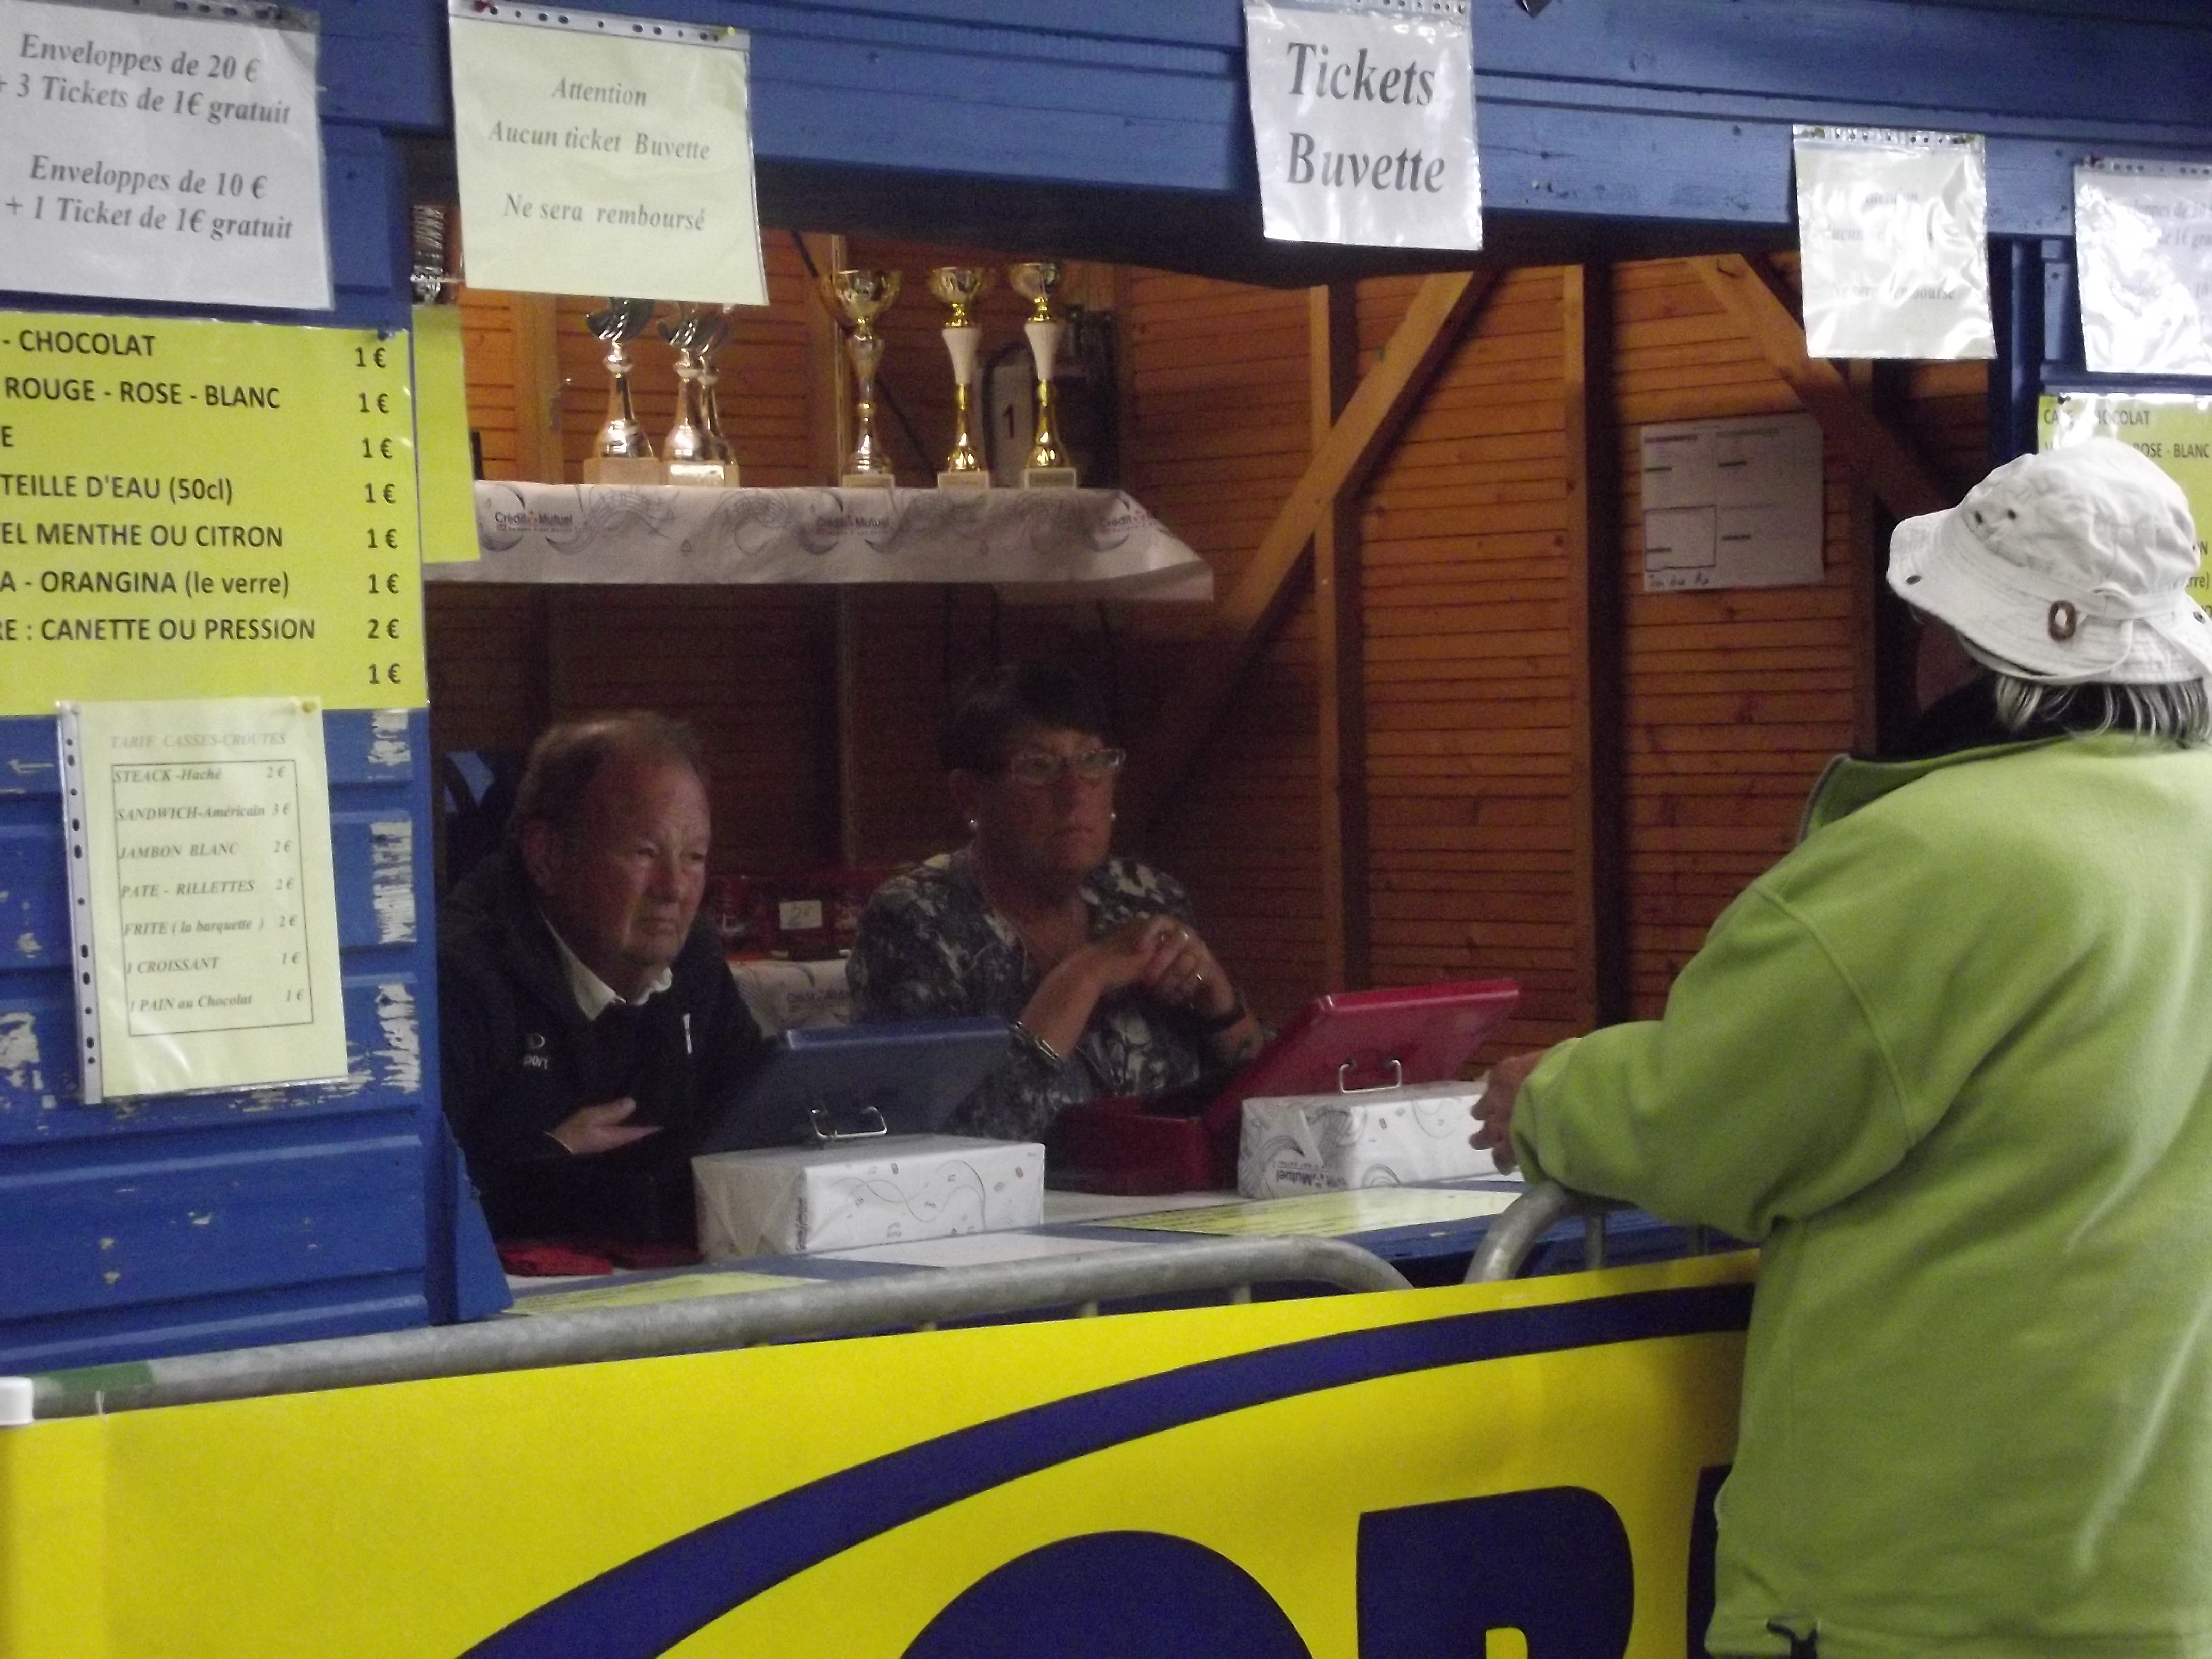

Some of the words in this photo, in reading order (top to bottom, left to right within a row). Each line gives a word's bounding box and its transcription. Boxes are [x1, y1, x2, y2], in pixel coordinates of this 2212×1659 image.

[21, 33, 163, 76] Enveloppes
[171, 51, 200, 76] de
[207, 55, 236, 79] 20
[245, 58, 260, 83] €
[1287, 42, 1435, 105] Tickets
[17, 74, 30, 98] 3
[43, 75, 128, 108] Tickets
[137, 87, 164, 112] de
[208, 100, 290, 125] gratuit
[552, 77, 648, 107] Attention
[489, 120, 557, 146] Aucun
[564, 126, 621, 152] ticket
[635, 132, 711, 161] Buvette
[30, 155, 170, 194] Enveloppes
[179, 170, 206, 194] de
[217, 173, 243, 197] 10
[252, 175, 267, 199] €
[1287, 132, 1445, 193] Buvette
[34, 195, 44, 219] 1
[57, 197, 132, 227] Ticket
[140, 205, 166, 230] de
[211, 216, 292, 240] gratuit
[504, 193, 532, 219] Ne
[540, 202, 583, 221] sera
[596, 204, 705, 231] remboursé
[19, 329, 156, 356] CHOCOLAT
[355, 347, 367, 367] 1
[373, 347, 386, 368] €
[5, 377, 96, 401] ROUGE
[120, 381, 182, 404] ROSE
[205, 384, 280, 409] BLANC
[359, 392, 370, 413] 1
[377, 393, 389, 414] €
[1, 425, 14, 447] E
[362, 437, 373, 458] 1
[380, 438, 393, 459] €
[2173, 443, 2210, 458] BLANC
[0, 474, 77, 496] TEILLE
[87, 475, 160, 499] D'EAU
[169, 477, 233, 504] (50cl)
[365, 483, 376, 503] 1
[383, 483, 396, 504] €
[2, 522, 27, 544] EL
[37, 523, 142, 546] MENTHE
[151, 524, 186, 546] OU
[196, 526, 283, 547] CITRON
[367, 528, 378, 548] 1
[385, 528, 398, 549] €
[0, 571, 16, 593] A
[41, 571, 177, 593] ORANGINA
[186, 570, 214, 598] (le
[222, 570, 289, 599] verre)
[368, 573, 379, 594] 1
[386, 574, 400, 595] €
[41, 619, 150, 641] CANETTE
[159, 619, 195, 640] OU
[205, 619, 315, 640] PRESSION
[367, 619, 379, 639] 2
[386, 619, 400, 640] €
[368, 664, 380, 684] 1
[388, 663, 401, 684] €
[110, 735, 154, 749] TARIF
[113, 769, 171, 783] STEACK
[266, 767, 273, 778] 2
[278, 766, 286, 778] €
[272, 803, 279, 815] 3
[283, 803, 291, 815] €
[118, 845, 181, 859] JAMBON
[190, 843, 239, 856] BLANC
[274, 841, 281, 853] 2
[284, 840, 292, 853] €
[121, 884, 160, 898] PATE
[176, 880, 255, 895] RILLETTES
[276, 879, 283, 890] 2
[287, 878, 295, 890] €
[124, 922, 168, 935] FRITE
[196, 919, 253, 934] barquette
[279, 916, 285, 928] 2
[290, 915, 297, 927] €
[137, 957, 220, 974] CROISSANT
[282, 953, 287, 965] 1
[292, 952, 300, 964] €
[140, 997, 175, 1012] PAIN
[178, 1000, 193, 1010] au
[198, 994, 253, 1008] Chocolat
[286, 990, 291, 1002] 1
[296, 989, 305, 1001] €
